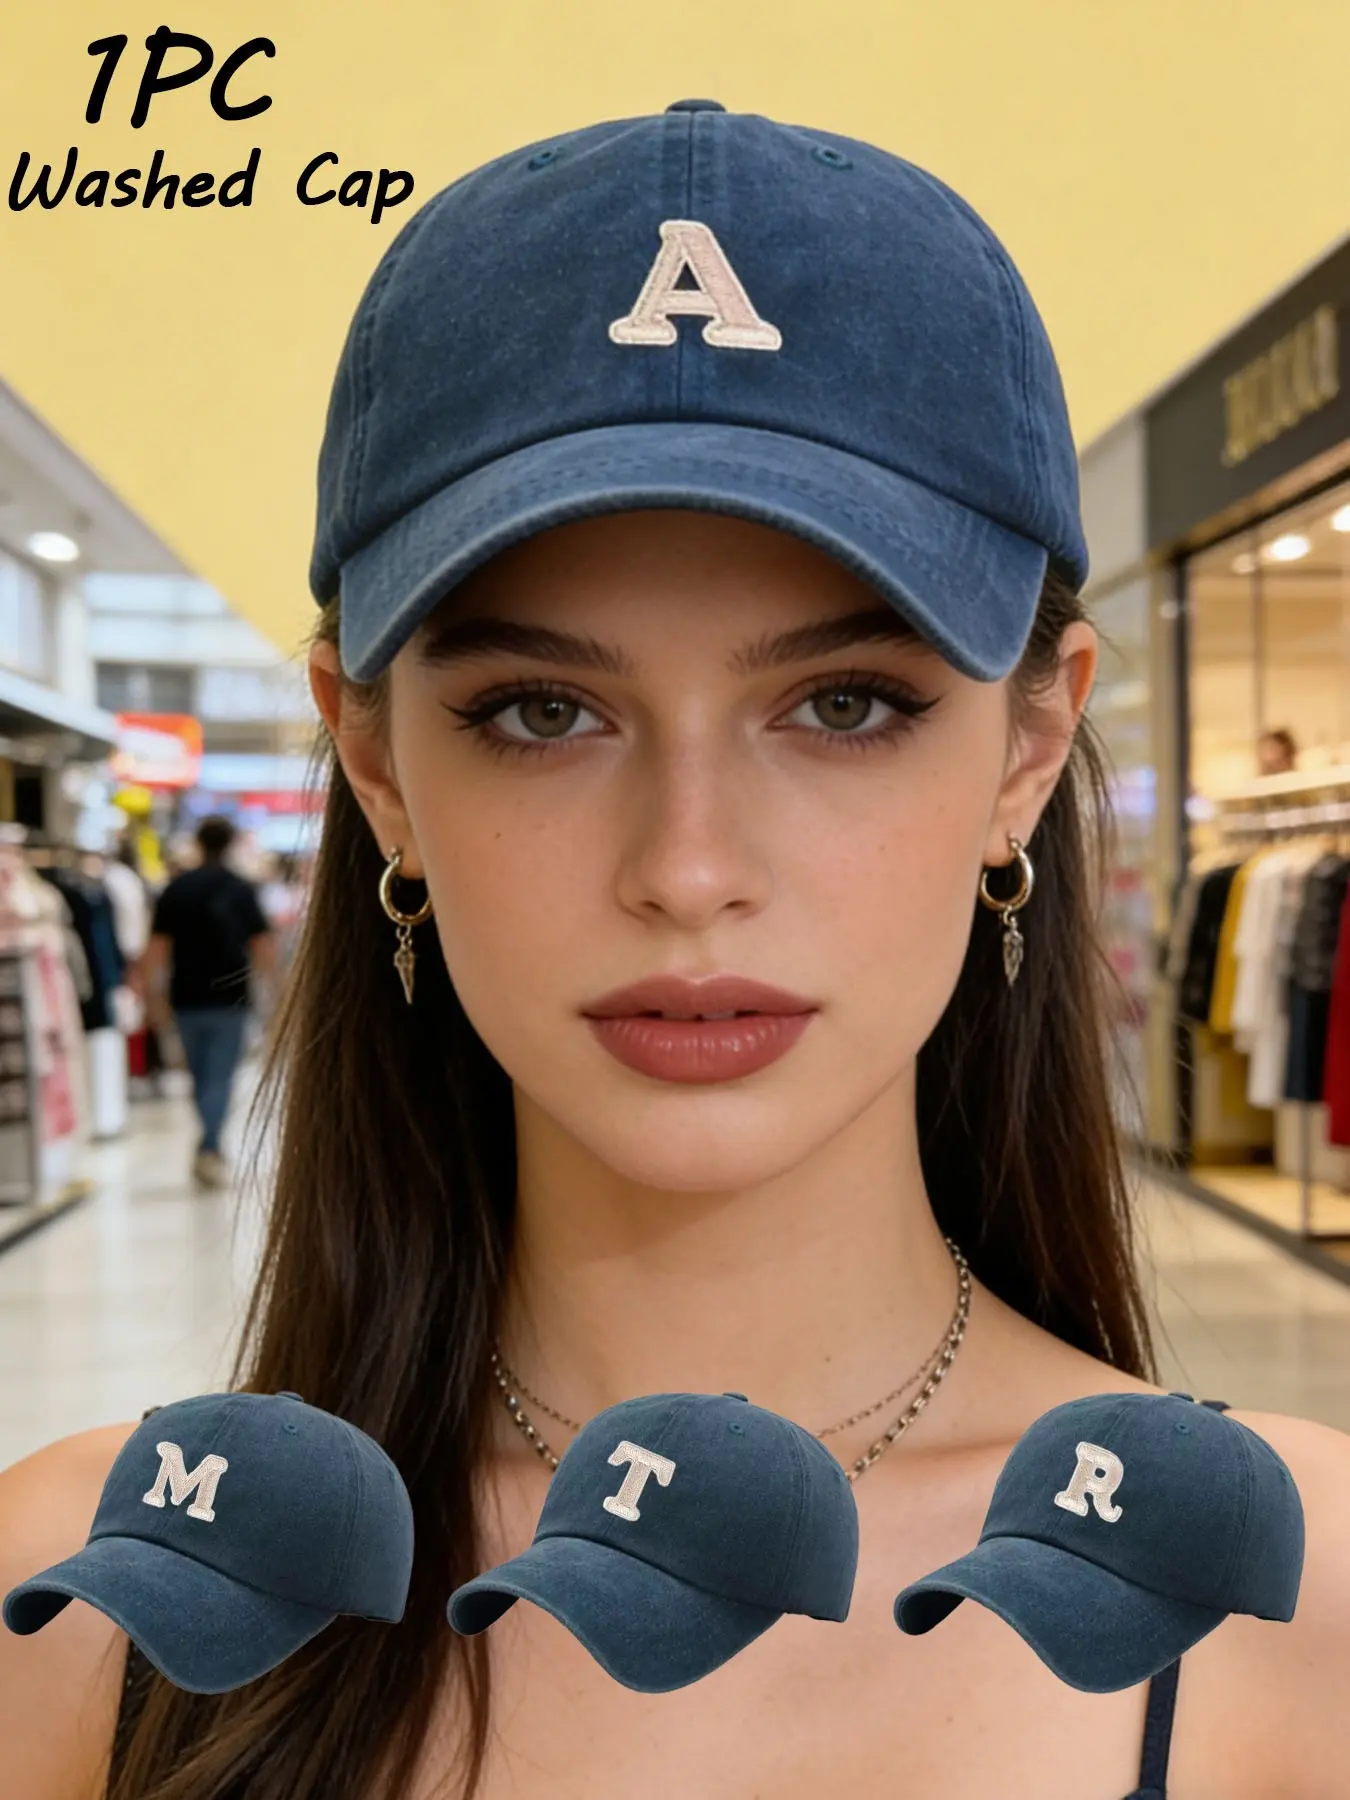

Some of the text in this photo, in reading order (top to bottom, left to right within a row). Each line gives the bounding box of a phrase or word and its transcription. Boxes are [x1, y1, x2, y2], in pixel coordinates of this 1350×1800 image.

[608, 219, 782, 350] A
[142, 1441, 229, 1522] M
[602, 1440, 676, 1522] T
[1053, 1441, 1123, 1522] R
